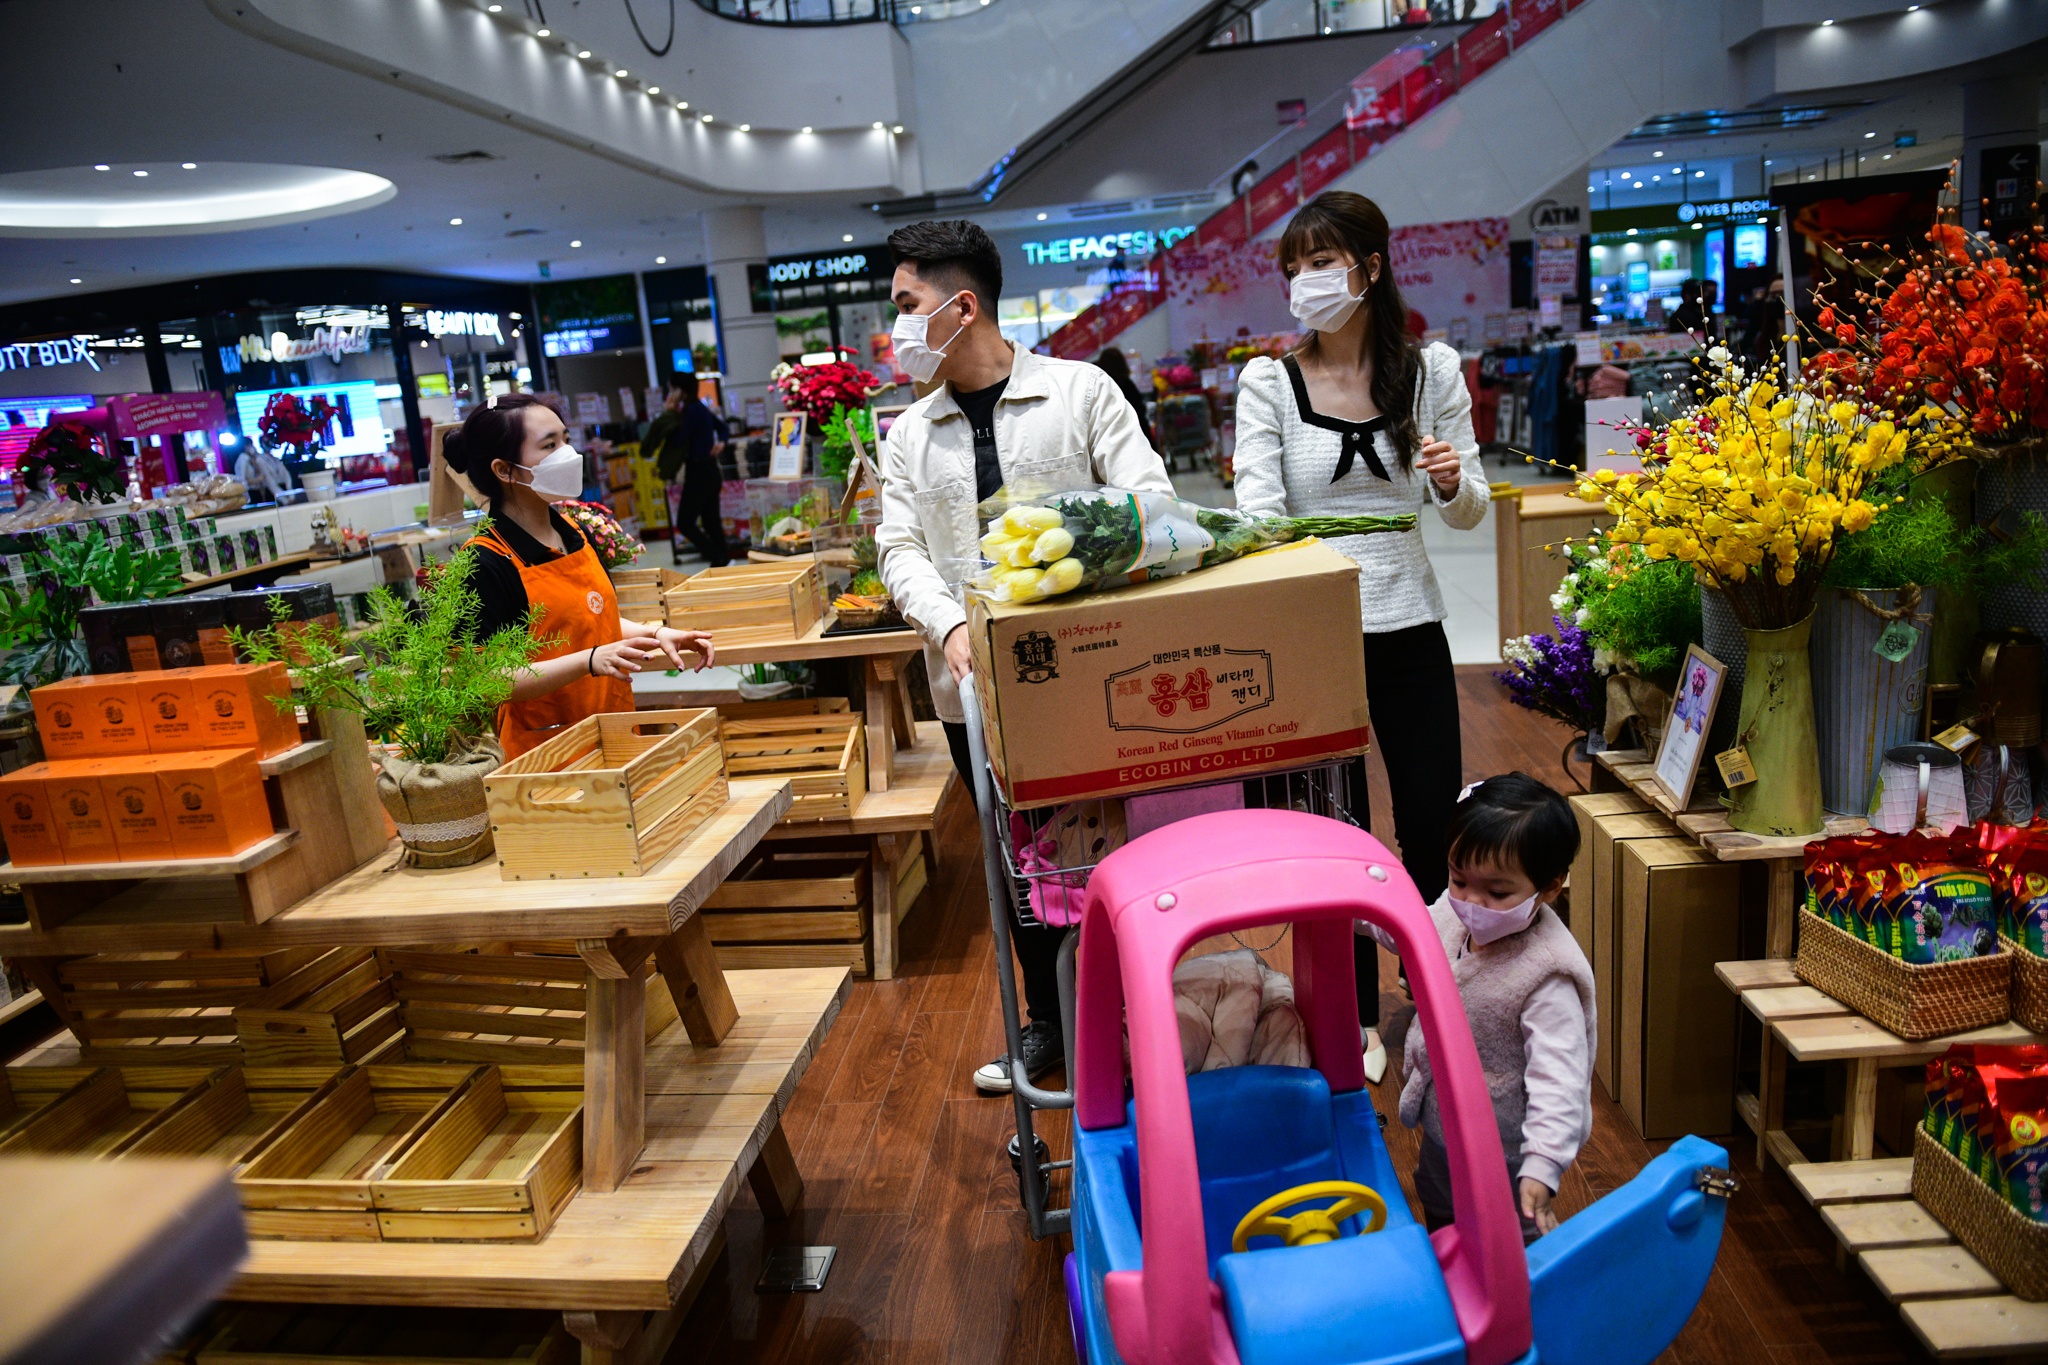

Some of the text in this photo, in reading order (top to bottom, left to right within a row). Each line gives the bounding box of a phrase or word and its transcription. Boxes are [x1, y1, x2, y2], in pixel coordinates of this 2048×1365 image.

[1540, 205, 1580, 225] ATM
[1696, 200, 1778, 217] YVES ROCH
[426, 310, 505, 345] BEAUTY BOX
[38, 337, 102, 372] BOX
[1023, 641, 1045, 654] 홍삼
[1025, 652, 1046, 664] 시대
[1153, 644, 1222, 665] 대한민국 특산품
[1216, 668, 1255, 684] 비타민
[1148, 667, 1213, 717] 홍삼
[1231, 684, 1261, 705] 캔디
[1117, 720, 1299, 759] Korean Red Ginseng Vitamin Candy
[1118, 760, 1191, 782] ECOBIN
